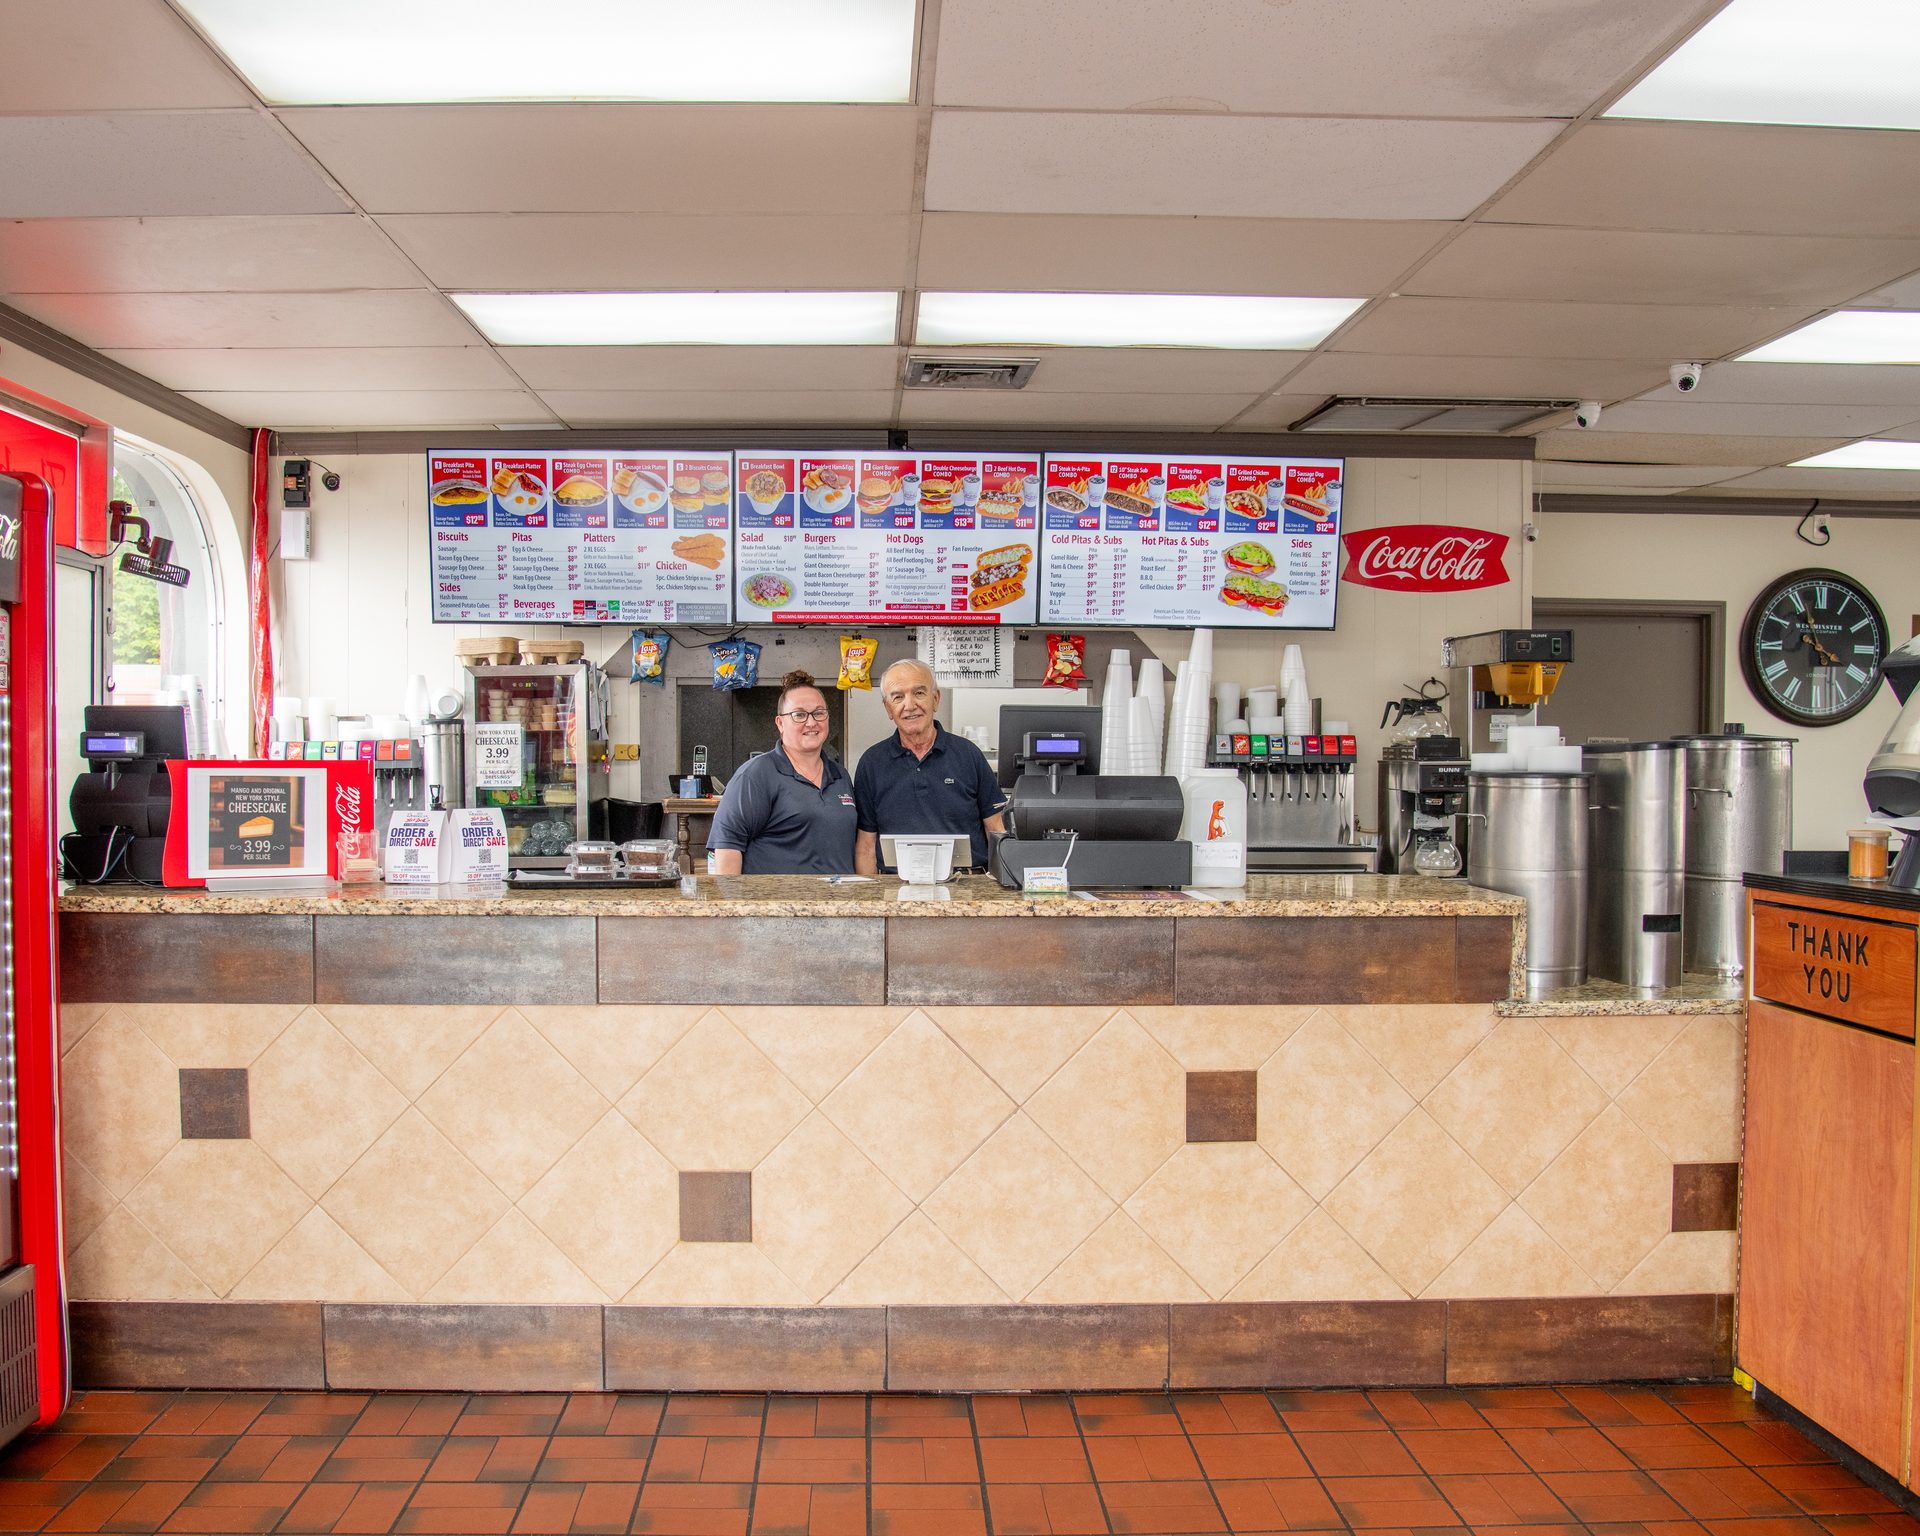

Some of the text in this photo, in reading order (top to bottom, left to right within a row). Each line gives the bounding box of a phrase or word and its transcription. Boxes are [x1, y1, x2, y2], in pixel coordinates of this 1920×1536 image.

[576, 462, 585, 470] Egg
[438, 532, 468, 542] Biscuits
[512, 532, 532, 542] Pitas
[584, 533, 616, 542] Platters
[741, 532, 764, 542] Salad
[804, 533, 836, 544] Burgers
[886, 534, 924, 545] Hot Dogs
[1052, 534, 1122, 544] Cold Pitas & Subs
[1142, 536, 1209, 546] Hot Pitas & Subs
[1291, 539, 1312, 548] Sides
[1358, 536, 1493, 580] Coca-Cola
[656, 561, 687, 570] Chicken
[440, 583, 460, 592] Sides
[514, 600, 556, 610] Beverages
[641, 645, 658, 654] Lay's
[848, 648, 866, 656] Lay's
[1854, 645, 1874, 654] III
[476, 738, 518, 746] CHEESECAKE
[486, 748, 508, 758] 3.99
[228, 802, 286, 814] CHEESECAKE
[391, 827, 425, 837] ORDER
[462, 827, 494, 837] ORDER
[244, 840, 270, 852] 3.99
[389, 838, 436, 847] DIRECT SAVE
[464, 837, 506, 848] DIRECT SAVE
[1788, 922, 1868, 966] THANK
[1804, 963, 1850, 1002] YOU
